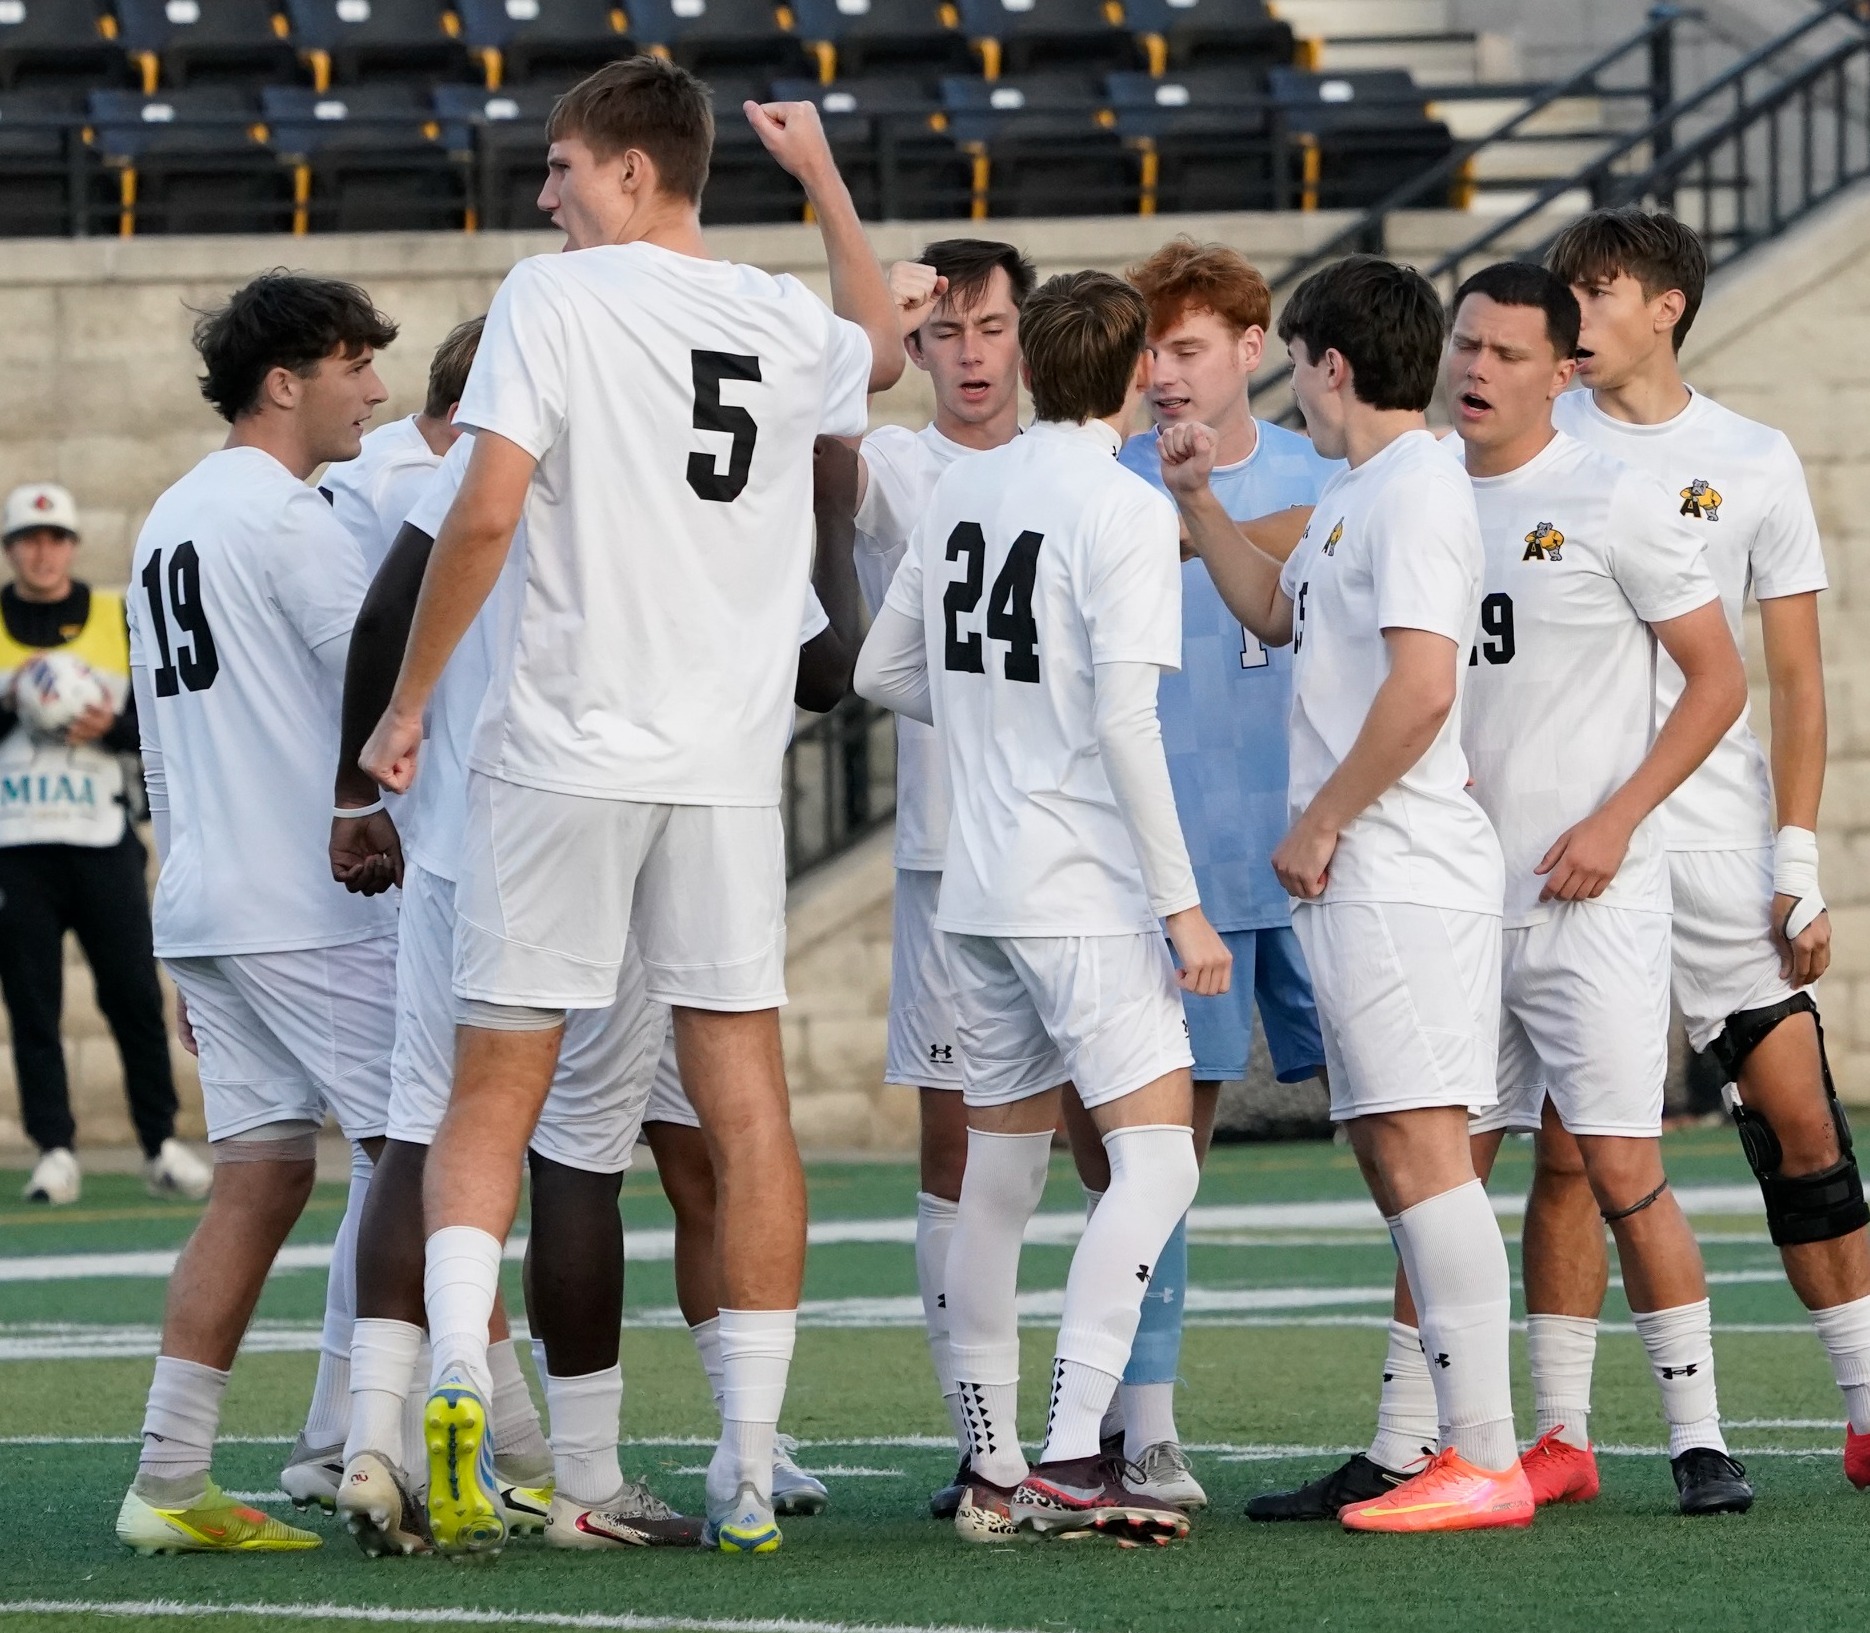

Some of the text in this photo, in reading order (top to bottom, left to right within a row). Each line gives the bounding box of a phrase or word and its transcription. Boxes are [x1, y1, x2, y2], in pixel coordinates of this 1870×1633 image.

[686, 349, 762, 503] 5
[142, 540, 220, 698] 19
[943, 520, 1045, 683] 24
[1468, 592, 1516, 667] 9
